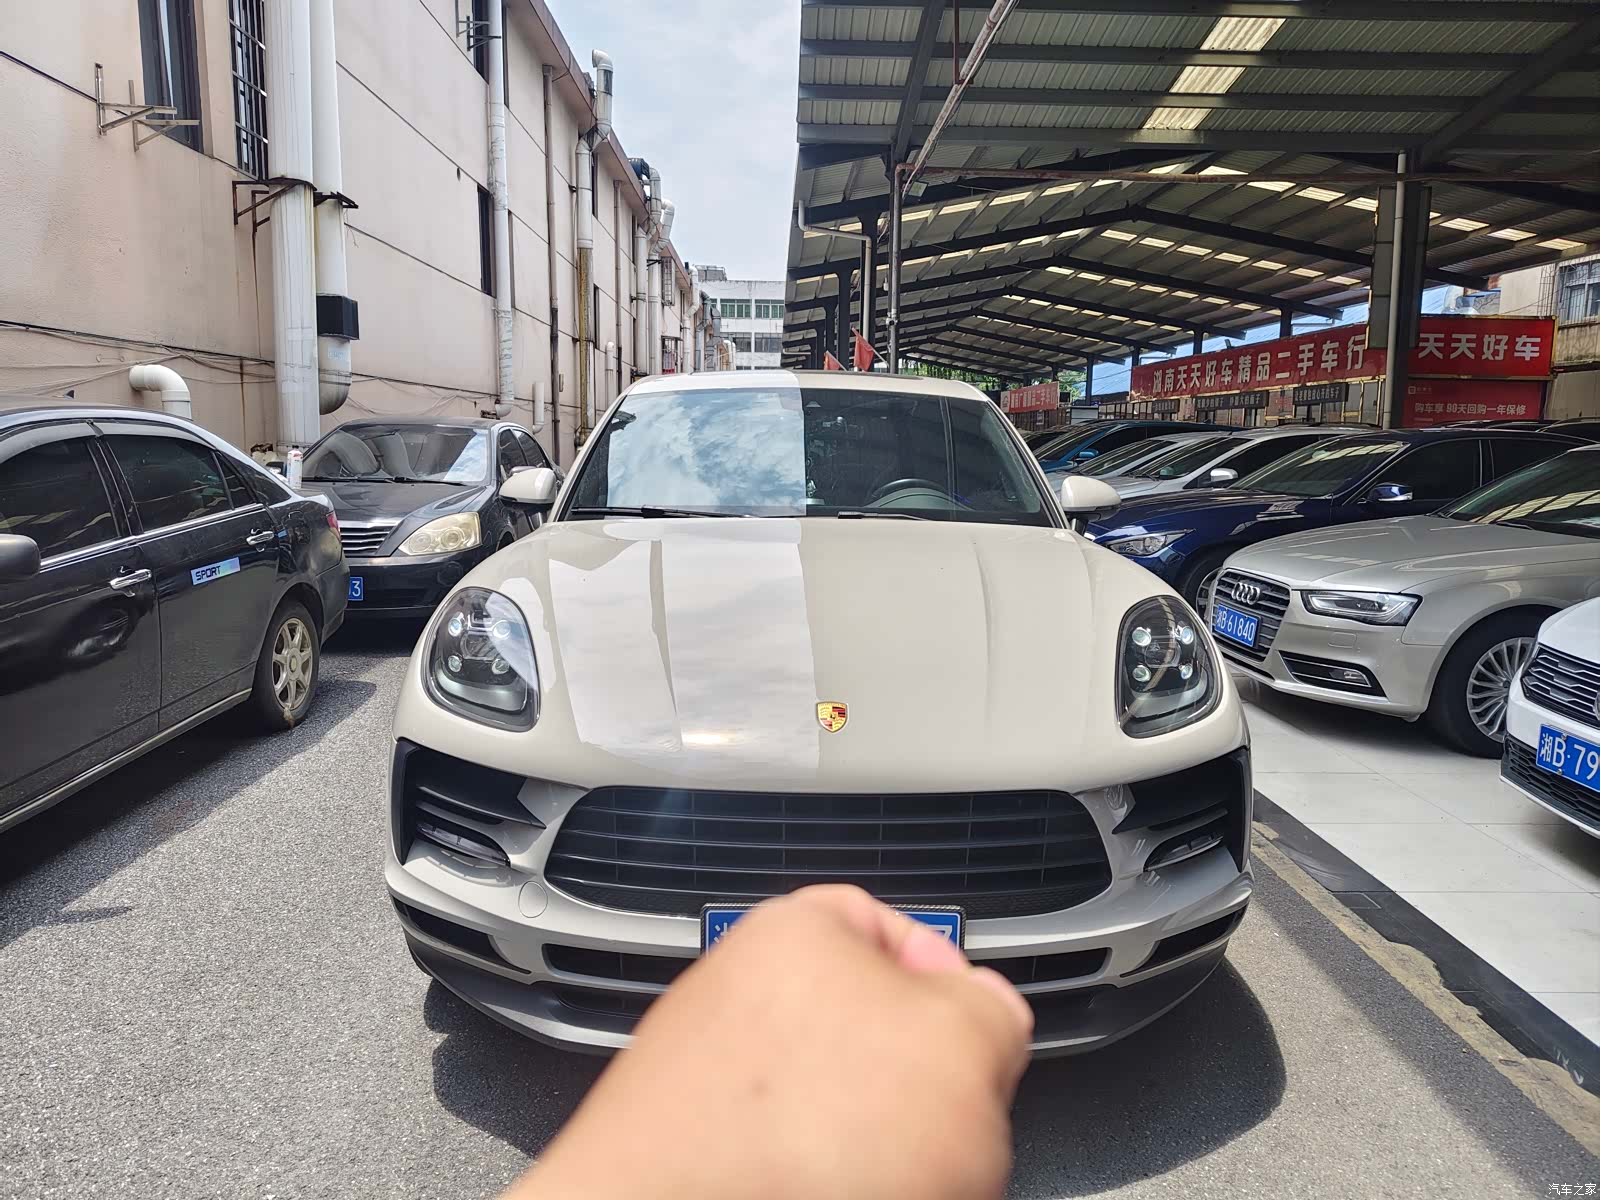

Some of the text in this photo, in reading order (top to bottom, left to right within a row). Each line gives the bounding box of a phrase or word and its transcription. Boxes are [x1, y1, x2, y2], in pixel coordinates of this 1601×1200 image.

[1418, 333, 1541, 361] 天天好车
[1153, 334, 1366, 393] 湖南天天好车精品二手车行
[194, 565, 221, 581] SPORT
